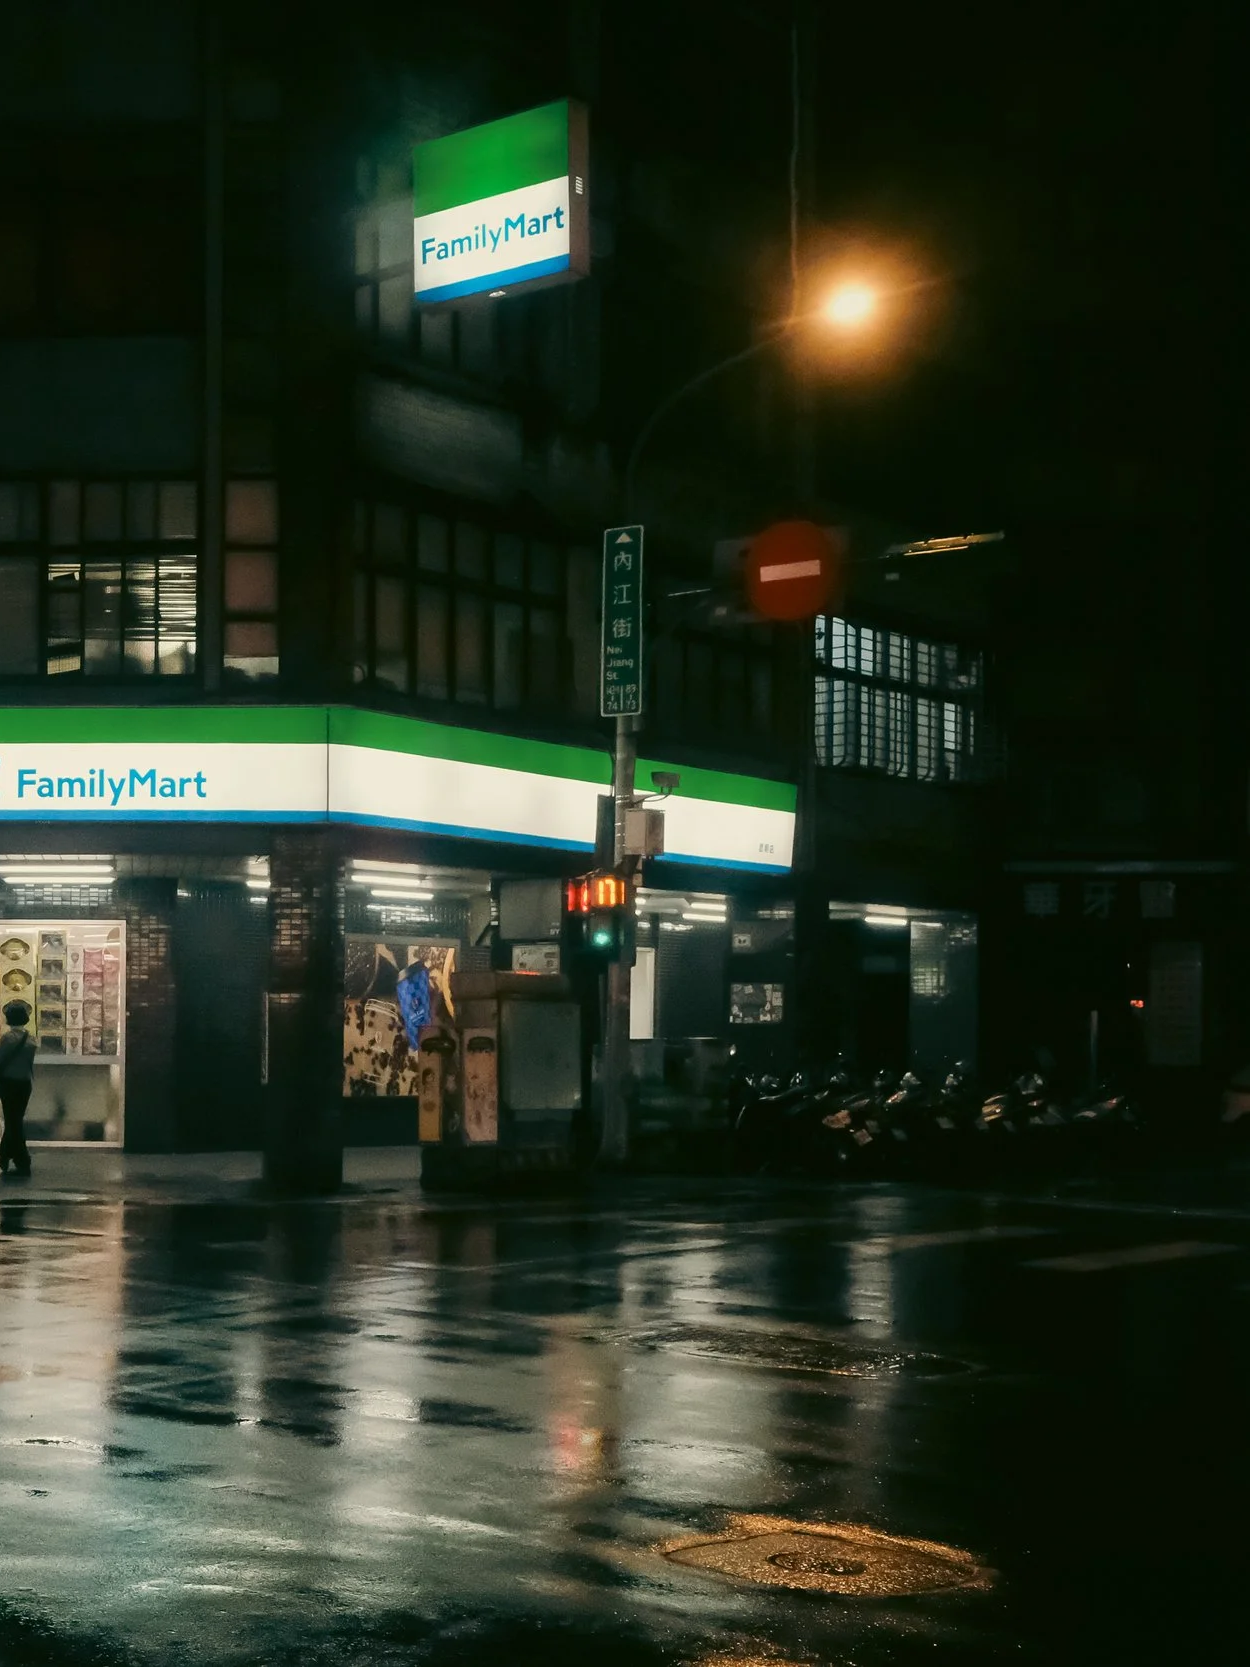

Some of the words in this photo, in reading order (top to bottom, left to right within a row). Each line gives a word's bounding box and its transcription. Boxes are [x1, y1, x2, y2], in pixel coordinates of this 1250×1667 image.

[421, 206, 565, 265] FamilyMart
[612, 551, 633, 639] 內江街
[606, 645, 623, 655] Nei
[606, 657, 634, 669] Jiang
[17, 768, 207, 807] FamilyMart
